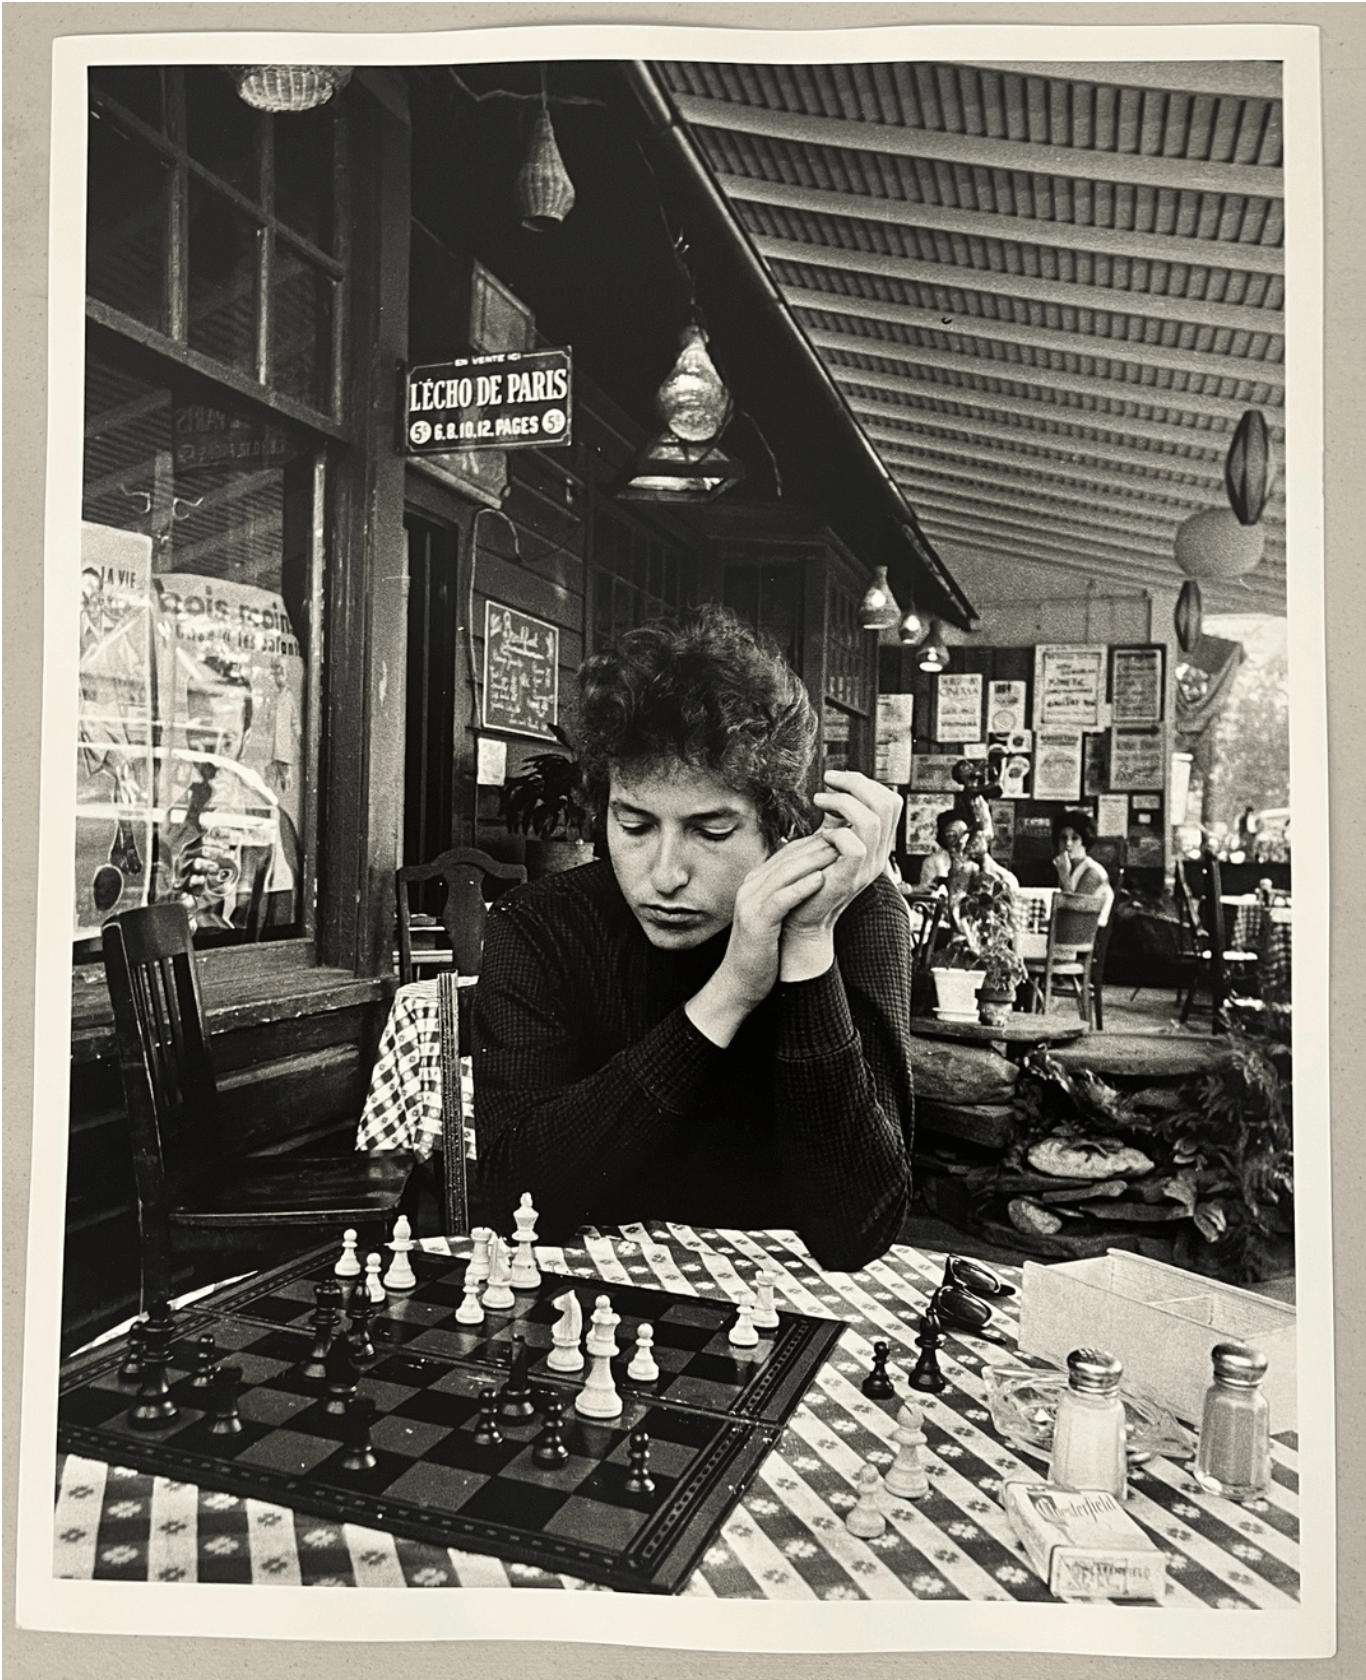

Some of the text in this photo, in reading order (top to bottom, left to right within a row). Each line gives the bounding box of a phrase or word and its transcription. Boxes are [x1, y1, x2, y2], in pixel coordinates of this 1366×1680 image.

[454, 358, 469, 367] EN
[471, 354, 506, 366] VENTE
[476, 375, 503, 407] DE
[507, 368, 568, 404] PARIS
[118, 569, 136, 589] VIE
